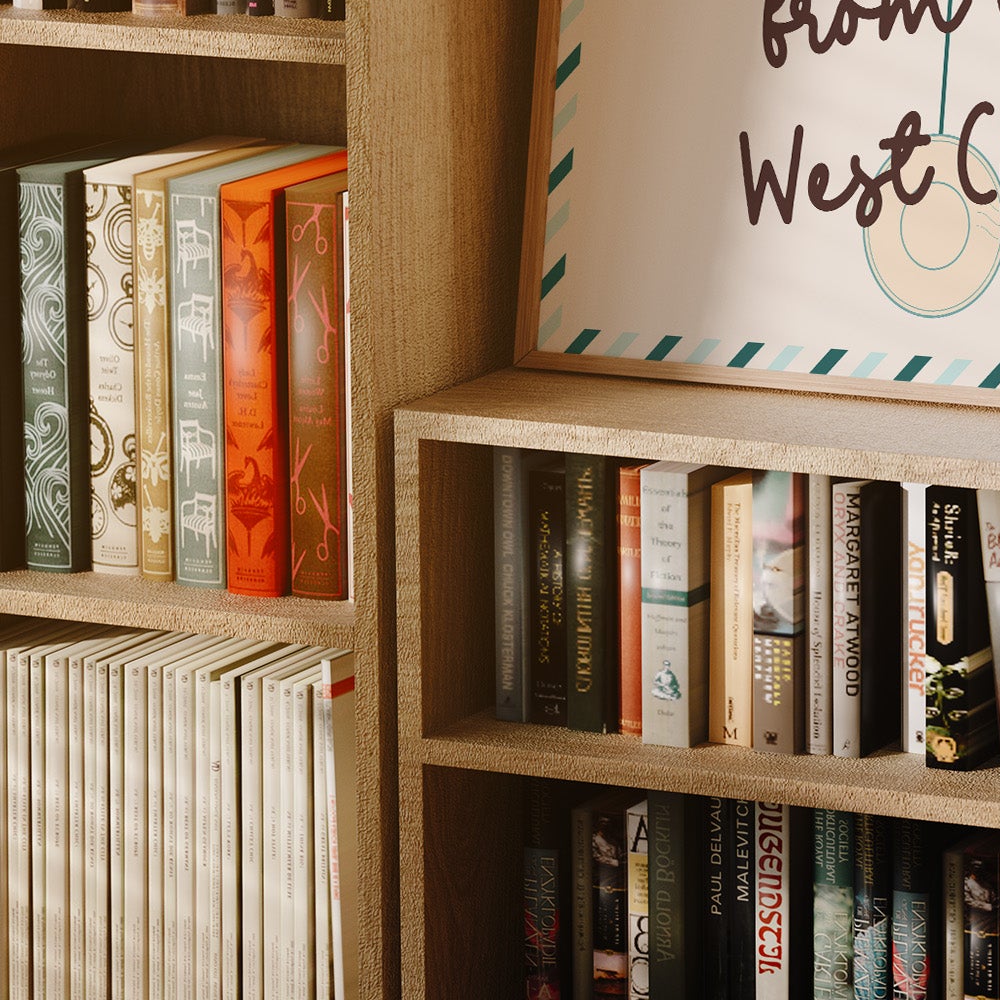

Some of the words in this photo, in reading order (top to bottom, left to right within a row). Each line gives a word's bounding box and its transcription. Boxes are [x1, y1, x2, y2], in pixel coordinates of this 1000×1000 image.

[739, 111, 934, 227] West
[501, 454, 513, 529] DOWNTOWN
[834, 492, 845, 544] ORYX
[502, 531, 513, 558] OWL
[650, 536, 682, 550] Theory
[834, 550, 845, 592] AND
[846, 493, 860, 606] MARGARET
[503, 564, 513, 606] CHUCK
[503, 609, 514, 691] KLOSTERMAN
[833, 599, 845, 669] CRAKE
[846, 611, 860, 697] ATWOOD
[722, 726, 738, 741] M
[711, 797, 722, 865] DELVAU
[710, 871, 722, 916] PAUL
